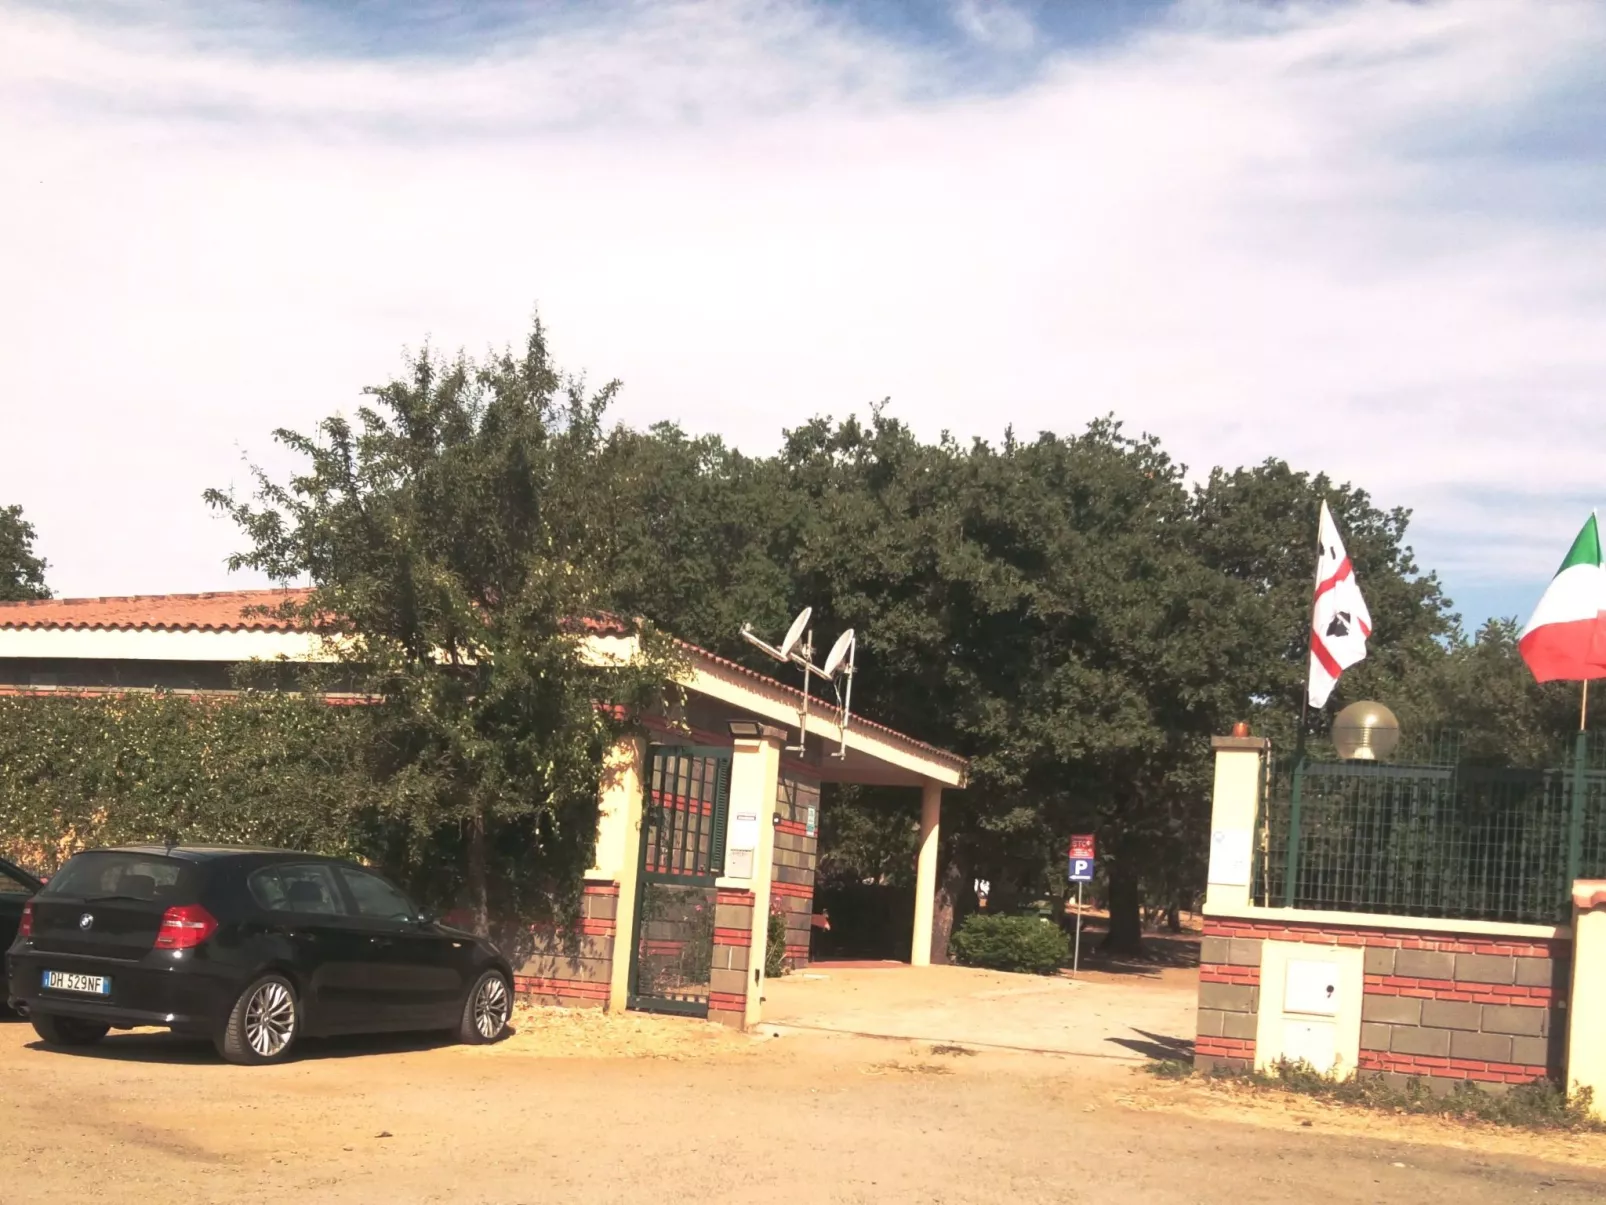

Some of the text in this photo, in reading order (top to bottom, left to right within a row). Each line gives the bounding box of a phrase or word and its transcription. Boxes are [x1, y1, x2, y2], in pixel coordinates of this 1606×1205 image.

[1075, 860, 1088, 874] P
[50, 972, 102, 991] DH 529NF
